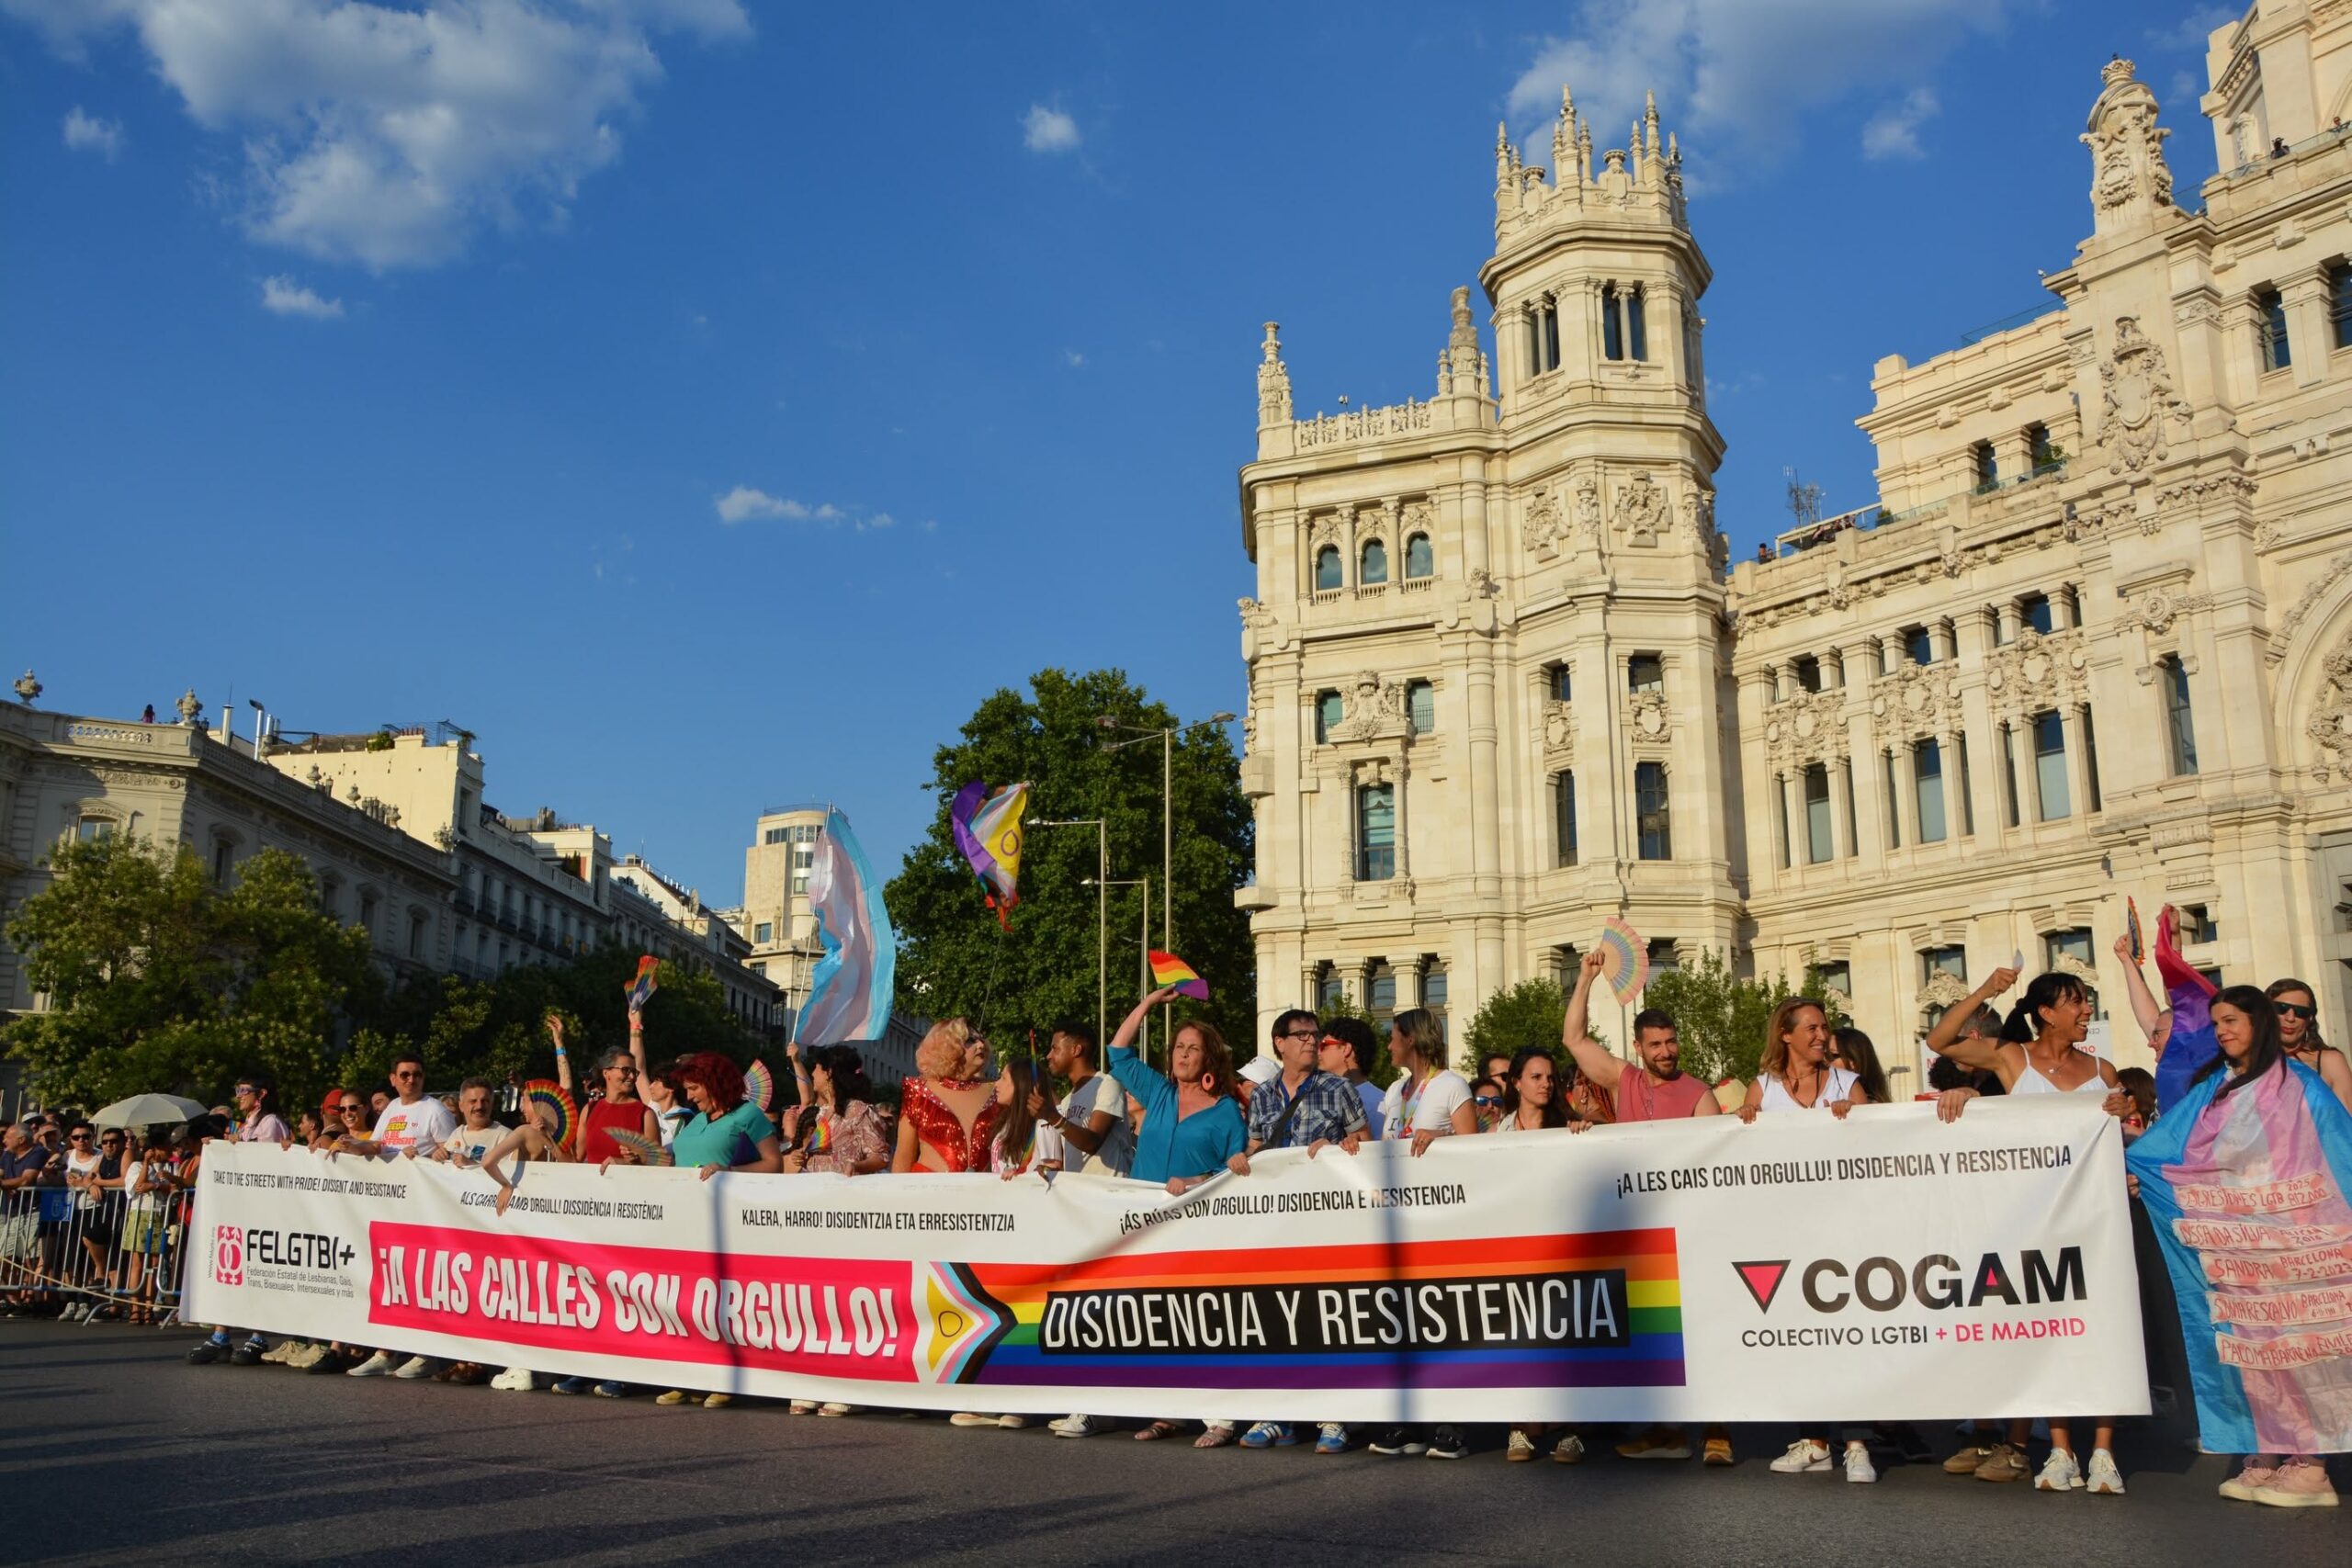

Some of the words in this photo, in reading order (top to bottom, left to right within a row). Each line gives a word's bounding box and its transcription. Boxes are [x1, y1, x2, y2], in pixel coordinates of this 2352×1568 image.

[213, 1170, 225, 1184] TAKE
[226, 1171, 233, 1185] TO
[233, 1172, 244, 1186] THE
[244, 1173, 276, 1189] STREETS
[277, 1175, 293, 1189] WITH
[294, 1177, 321, 1191] PRIDE!
[348, 1181, 364, 1195] AND
[365, 1182, 407, 1199] RESISTANCE
[1617, 1173, 1634, 1200] ¡A
[1637, 1171, 1667, 1193] LES
[1671, 1168, 1708, 1190] CAIS
[1713, 1165, 1746, 1187] CON
[1750, 1159, 1832, 1185] ORGULLU!
[1838, 1154, 1936, 1180] DISIDENCIA
[1939, 1153, 1951, 1174] Y
[1956, 1145, 2072, 1173] RESISTENCIA
[460, 1191, 474, 1206] ALS
[509, 1194, 529, 1211] AMB
[530, 1198, 561, 1214] ORGULL!
[563, 1197, 611, 1217] DISSIDÈNCIA
[612, 1204, 616, 1218] I
[616, 1201, 663, 1221] RESISTÈNCIA
[742, 1209, 783, 1230] KALERA,
[785, 1211, 823, 1228] HARRO!
[826, 1211, 892, 1230] DISIDENTZIA
[896, 1213, 915, 1230] ETA
[919, 1213, 1015, 1232] ERRESISTENTZIA
[1143, 1204, 1182, 1227] RÚAS
[1184, 1199, 1210, 1219] CON
[1212, 1194, 1274, 1215] ORGULLO!
[1278, 1190, 1354, 1213] DISIDENCIA
[1358, 1190, 1367, 1209] E
[1371, 1184, 1466, 1208] RESISTENCIA
[277, 1269, 298, 1280] Estatal
[299, 1271, 306, 1281] de
[2214, 1258, 2274, 1280] SANDRA
[2280, 1248, 2343, 1269] BARCELONA
[1801, 1246, 2089, 1314] COGAM
[379, 1245, 409, 1307] ¡A
[414, 1248, 472, 1315] LAS
[479, 1255, 602, 1330] CALLES
[606, 1269, 688, 1337] CON
[692, 1277, 899, 1358] ORGULLO!
[1045, 1290, 1267, 1348] DISIDENCIA
[1278, 1290, 1301, 1347] Y
[1318, 1278, 1619, 1347] RESISTENCIA
[2301, 1290, 2346, 1309] BARCELONA
[1741, 1326, 1864, 1348] COLECTIVO
[1871, 1325, 1928, 1346] LGTBI
[1936, 1328, 1947, 1341] +
[1955, 1323, 1984, 1343] DE
[1991, 1317, 2086, 1341] MADRID
